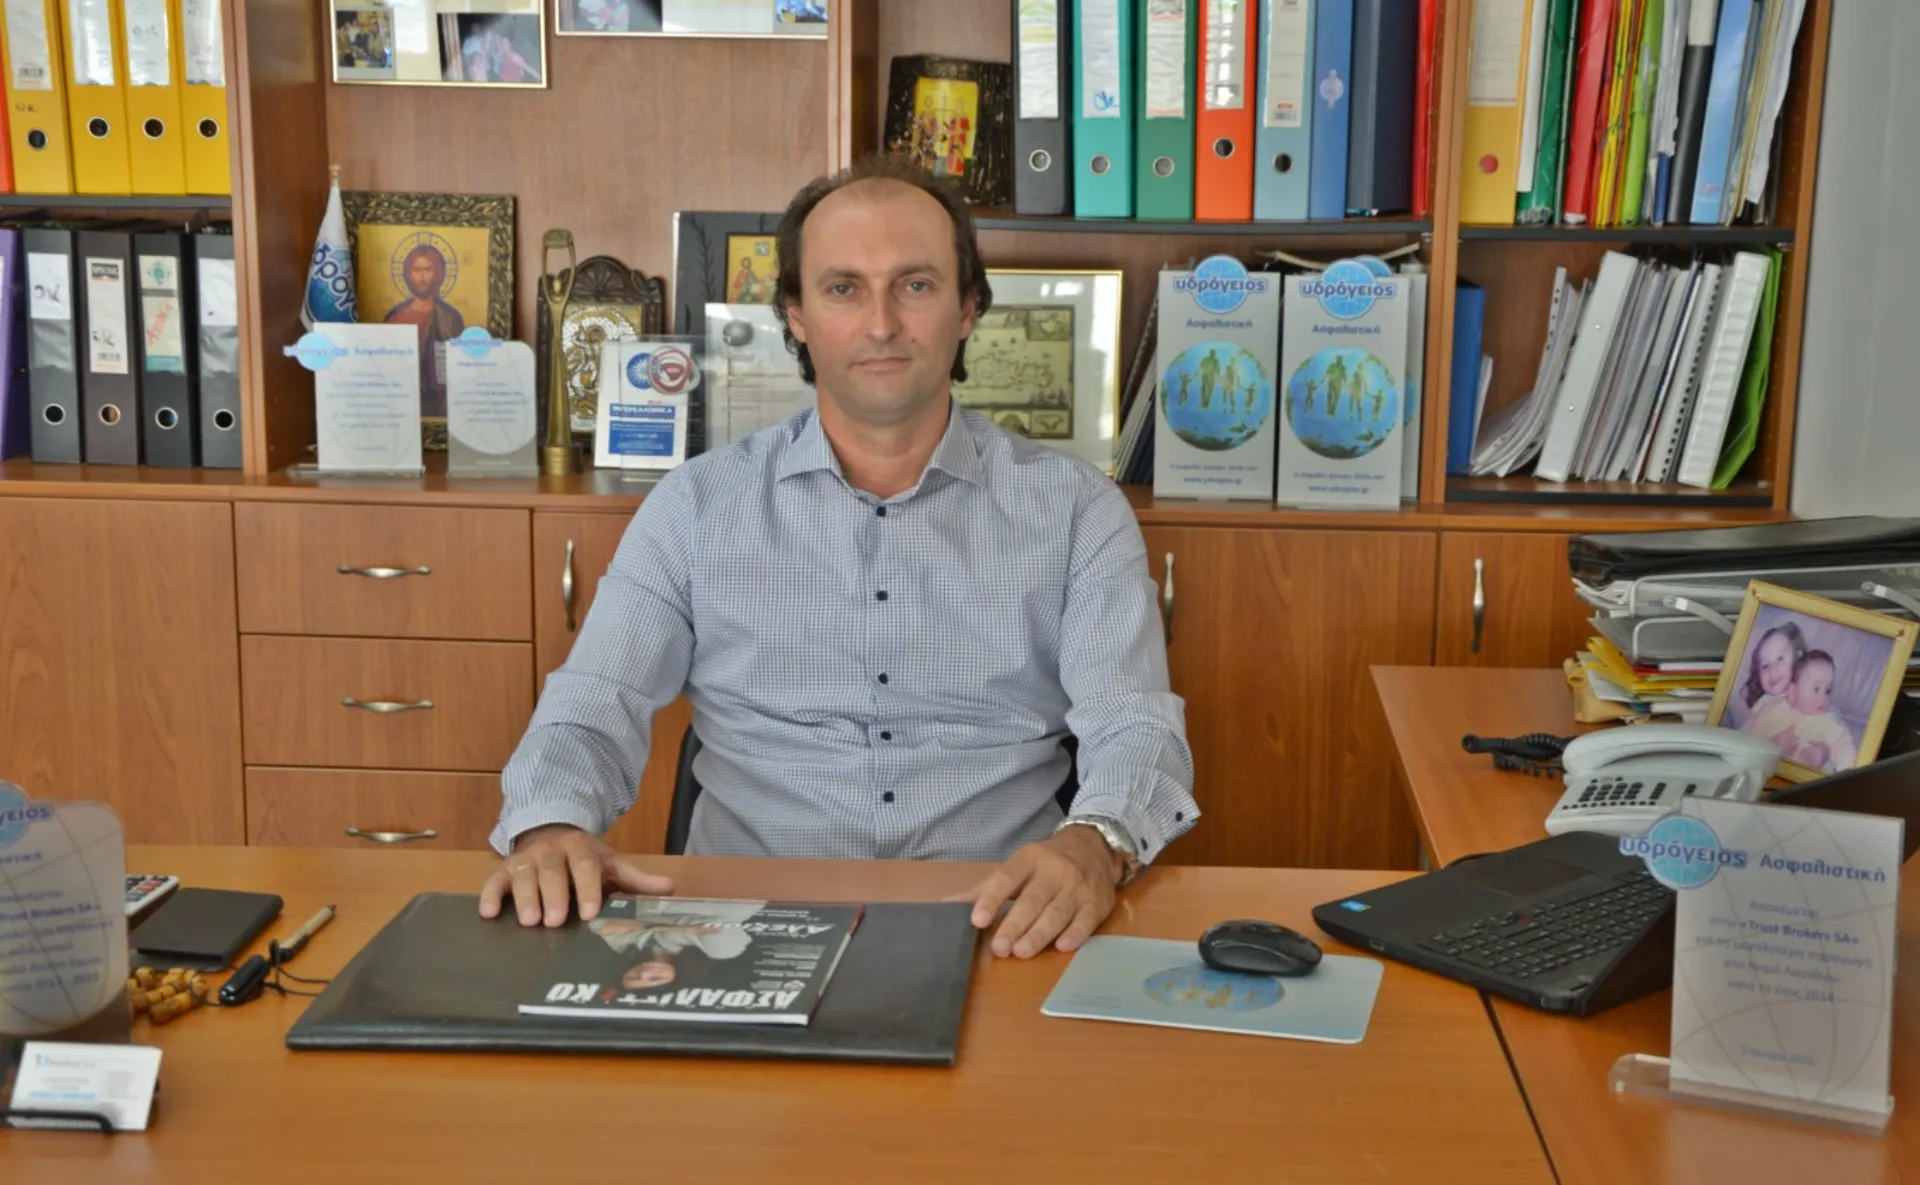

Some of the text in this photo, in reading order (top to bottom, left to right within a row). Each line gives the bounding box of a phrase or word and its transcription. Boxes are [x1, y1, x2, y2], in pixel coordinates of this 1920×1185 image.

[1177, 279, 1265, 294] υδρόγειος
[1303, 284, 1393, 299] υδρόγειος
[1621, 837, 1886, 883] υδρόγειος Ασφαλιστική
[1782, 924, 1831, 942] Brokers
